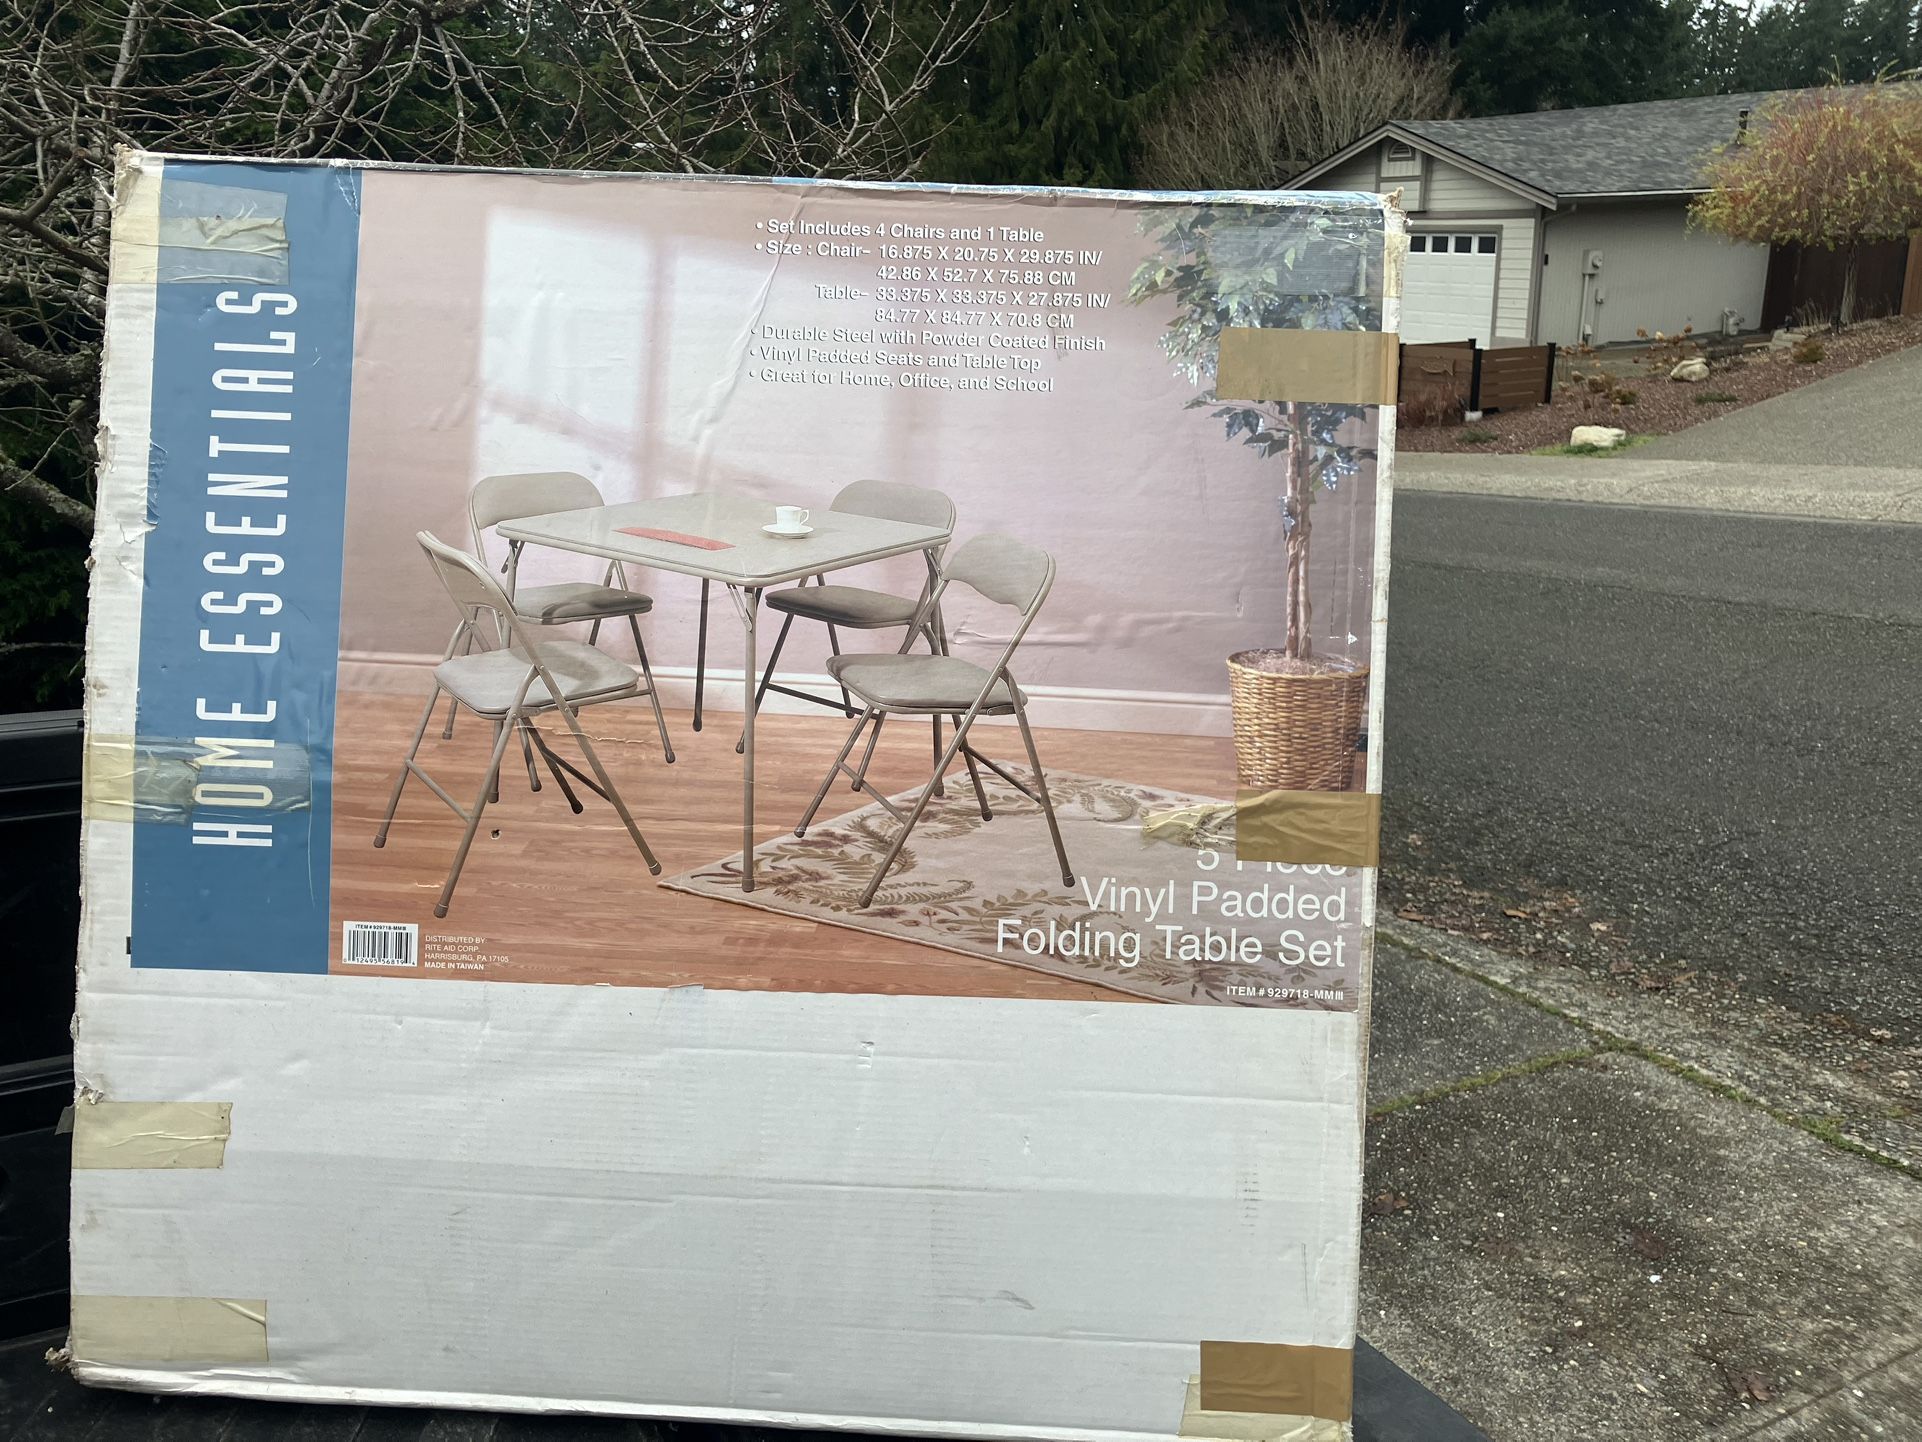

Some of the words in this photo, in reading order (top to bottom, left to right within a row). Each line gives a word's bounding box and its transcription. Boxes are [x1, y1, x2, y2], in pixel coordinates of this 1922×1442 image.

[767, 219, 795, 233] Set
[799, 220, 870, 237] Includes
[875, 222, 885, 237] 4
[890, 223, 945, 240] Chairs
[949, 226, 981, 241] and
[987, 228, 994, 240] 1
[1000, 227, 1044, 242] Table
[766, 240, 801, 255] Size
[878, 244, 932, 260] 16.875
[937, 246, 949, 260] X
[953, 247, 998, 262] 20.75
[1003, 248, 1015, 263] X
[1019, 249, 1074, 264] 29.875
[1078, 250, 1103, 266] IN/
[876, 265, 922, 280] 42.86
[926, 267, 938, 281] X
[943, 268, 978, 282] 52.7
[982, 269, 994, 283] X
[999, 269, 1043, 285] 75.88
[1048, 271, 1076, 286] CM
[875, 287, 931, 302] 33.375
[935, 288, 947, 303] X
[952, 289, 1006, 305] 33.375
[1011, 291, 1023, 305] X
[1028, 292, 1082, 307] 27.875
[1087, 293, 1111, 308] IN/
[875, 308, 920, 323] 84.77
[924, 309, 937, 324] X
[941, 310, 986, 325] 84.77
[990, 312, 1002, 327] X
[1007, 312, 1042, 328] 70.8
[1046, 314, 1074, 329] CM
[762, 325, 828, 342] Durable
[833, 327, 875, 343] Steel
[880, 329, 916, 345] with
[921, 330, 984, 347] Powder
[989, 332, 1049, 349] Coated
[1054, 335, 1106, 351] Finish
[760, 346, 801, 365] Vinyl
[807, 348, 870, 365] Padded
[875, 350, 923, 367] Seats
[927, 353, 959, 368] and
[962, 353, 1007, 369] Table
[1010, 354, 1041, 373] Top
[760, 366, 806, 384] Great
[811, 369, 837, 384] for
[840, 370, 895, 388] Home,
[899, 372, 954, 391] Office,
[958, 375, 990, 390] and
[994, 375, 1054, 393] School
[199, 290, 298, 654] ESSENTIALS
[192, 697, 277, 847] HOME
[1196, 848, 1220, 871] 5
[1080, 876, 1175, 922] Vinyl
[1191, 880, 1346, 922] Padded
[425, 935, 473, 943] DISTRIBUTED
[997, 918, 1141, 968] Folding
[1156, 924, 1262, 964] Table
[1278, 928, 1346, 968] Set
[424, 961, 446, 969] MADE
[457, 962, 484, 970] TAIWAN
[489, 955, 509, 963] 17105
[1226, 986, 1256, 997] ITEM
[1258, 987, 1265, 997] #
[1267, 988, 1344, 1000] 929718-MMIII
